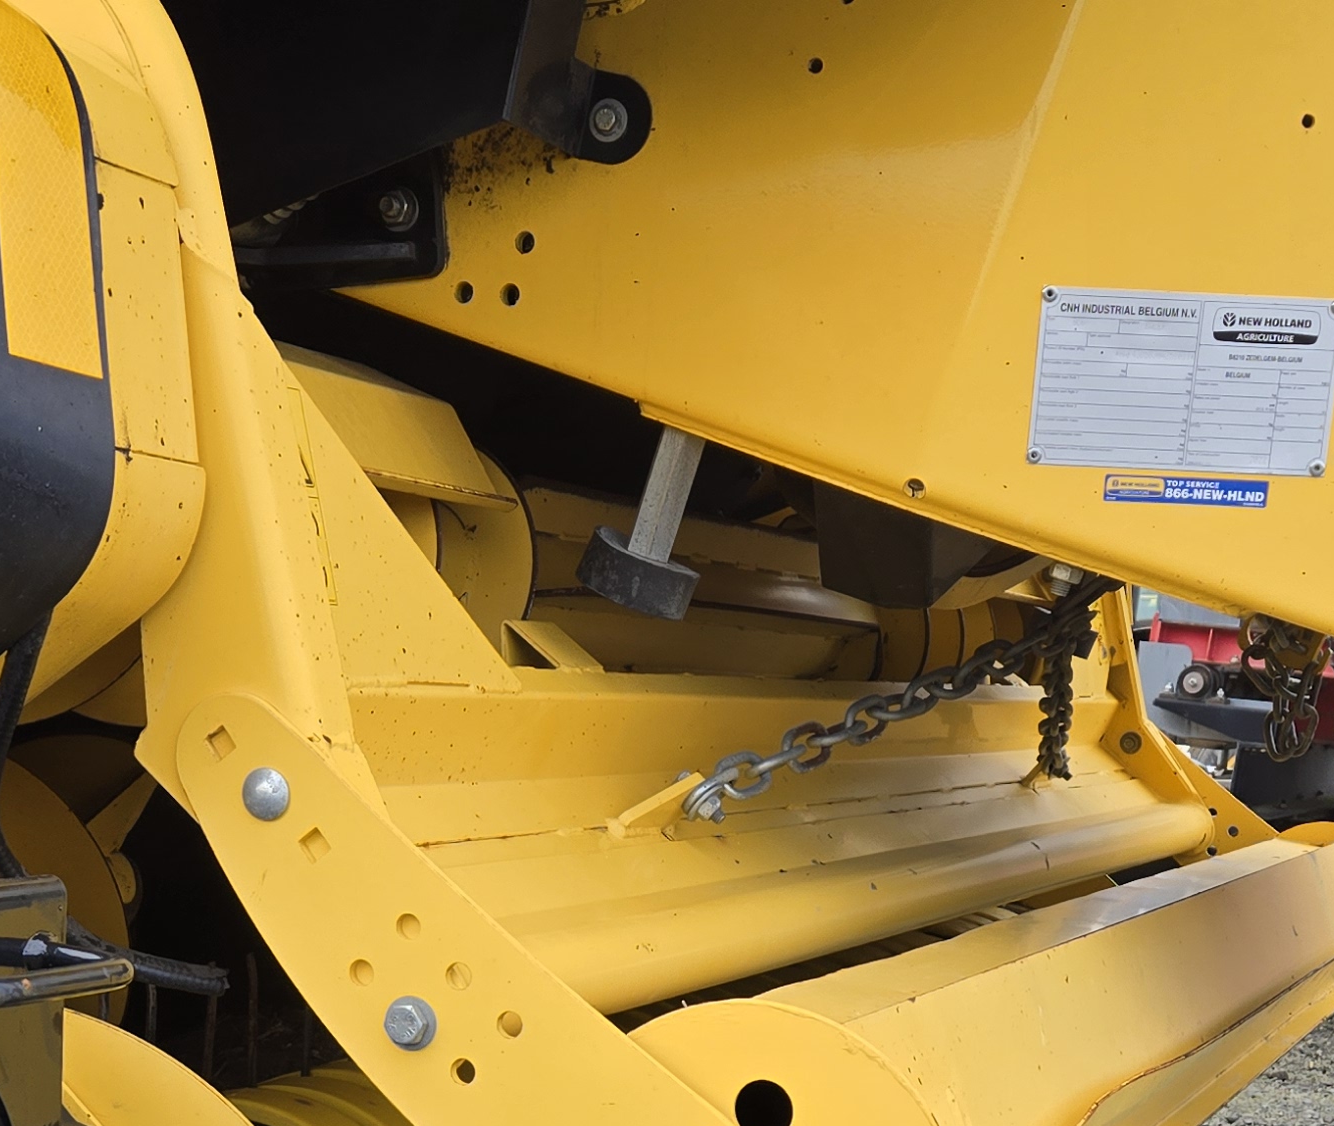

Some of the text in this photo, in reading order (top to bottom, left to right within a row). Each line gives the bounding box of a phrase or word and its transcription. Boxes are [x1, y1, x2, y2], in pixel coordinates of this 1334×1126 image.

[1060, 302, 1198, 318] CNH INDUSTRIAL BELGIUM N.V.
[1238, 317, 1312, 329] NEW HOLLAND
[1236, 333, 1295, 343] AGRICULTURE
[1225, 371, 1251, 379] BELGIUM
[1167, 479, 1220, 489] TOP SERVICE
[1165, 487, 1265, 503] 866-NEW-HLND
